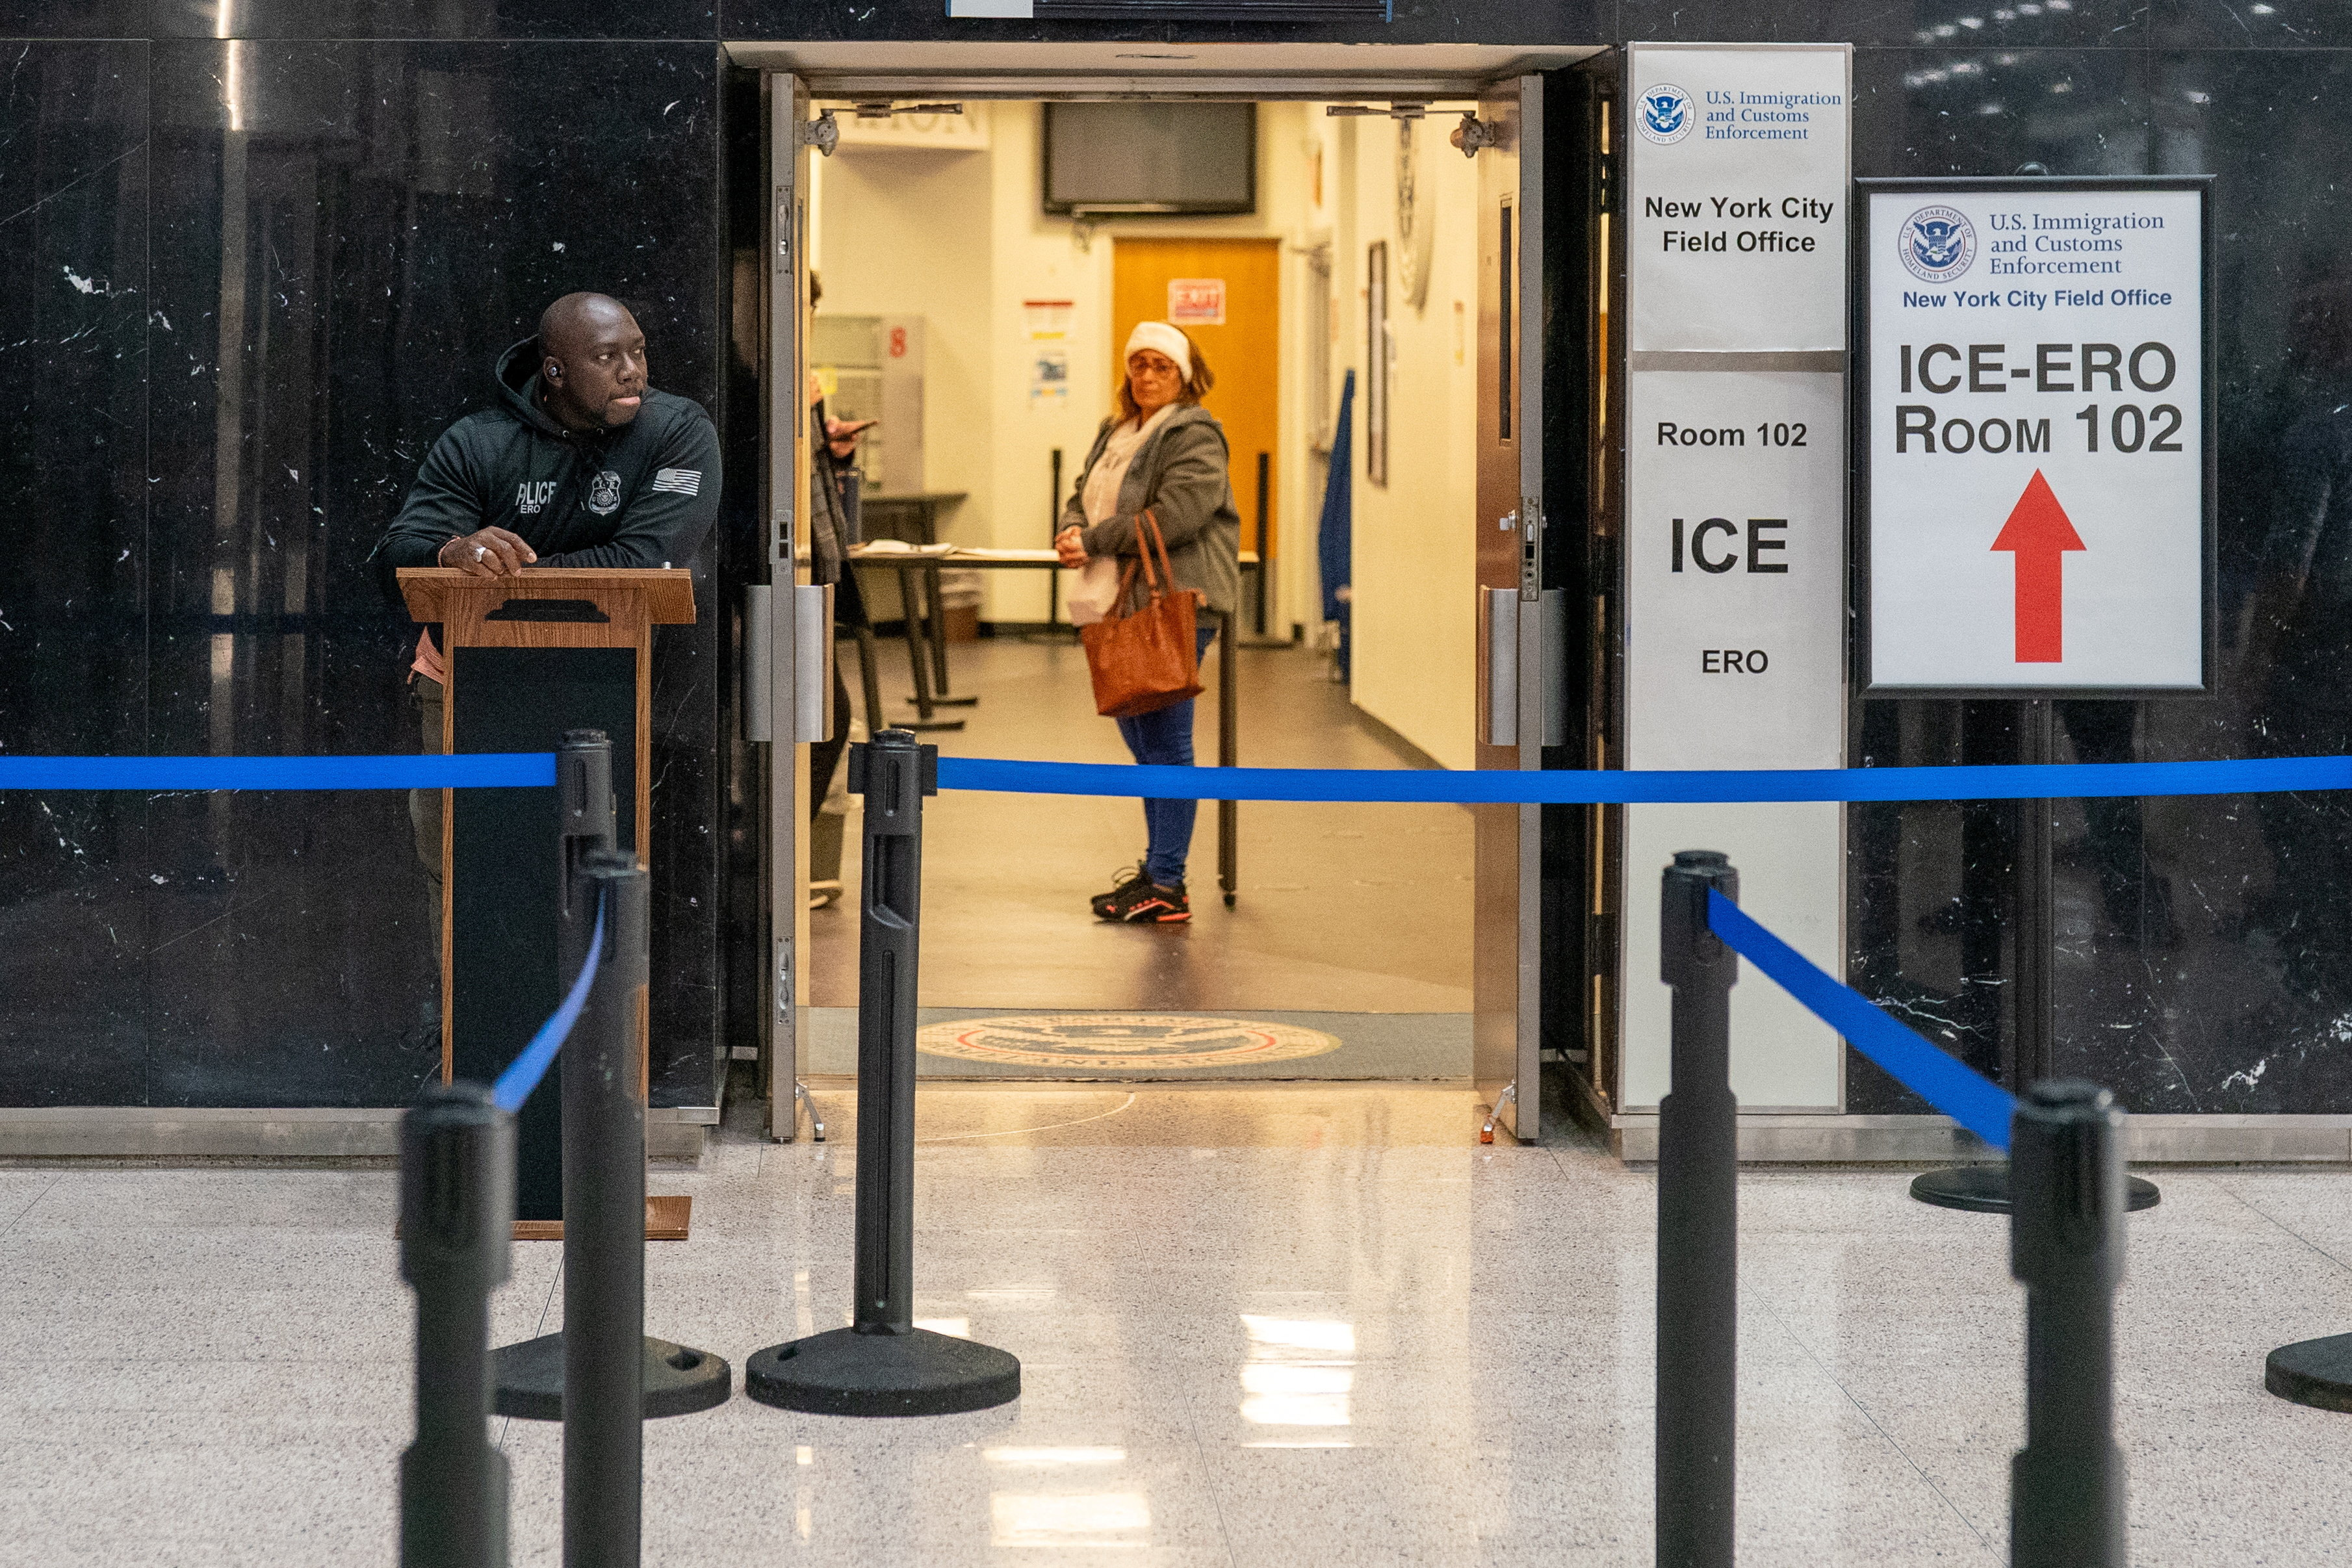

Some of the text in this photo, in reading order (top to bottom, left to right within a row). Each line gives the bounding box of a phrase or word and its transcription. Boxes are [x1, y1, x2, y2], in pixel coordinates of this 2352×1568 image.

[1647, 86, 1688, 101] DEPARTMENT
[1706, 91, 1841, 109] U.S. Immigration
[1707, 108, 1809, 122] and Customs
[1637, 118, 1693, 143] HOMELAND SECURITY
[1706, 125, 1807, 139] Enforcement
[1646, 197, 1834, 224] New York City
[1914, 209, 1968, 228] DEPARTMENT
[1989, 213, 2164, 235] U.S. Immigration
[1663, 231, 1815, 252] Field Office
[1991, 235, 2123, 253] and Customs
[1902, 248, 1973, 280] HOMELAND SECURITY
[1990, 257, 2121, 274] Enforcement
[1904, 289, 2172, 311] New York City Field Office
[890, 327, 907, 357] 8
[1900, 341, 2176, 394] ICE-ERO
[1658, 422, 1807, 447] Room 102
[2076, 404, 2182, 454] 102
[520, 504, 541, 514] ERO
[1672, 518, 1789, 574] ICE
[1702, 650, 1768, 674] ERO
